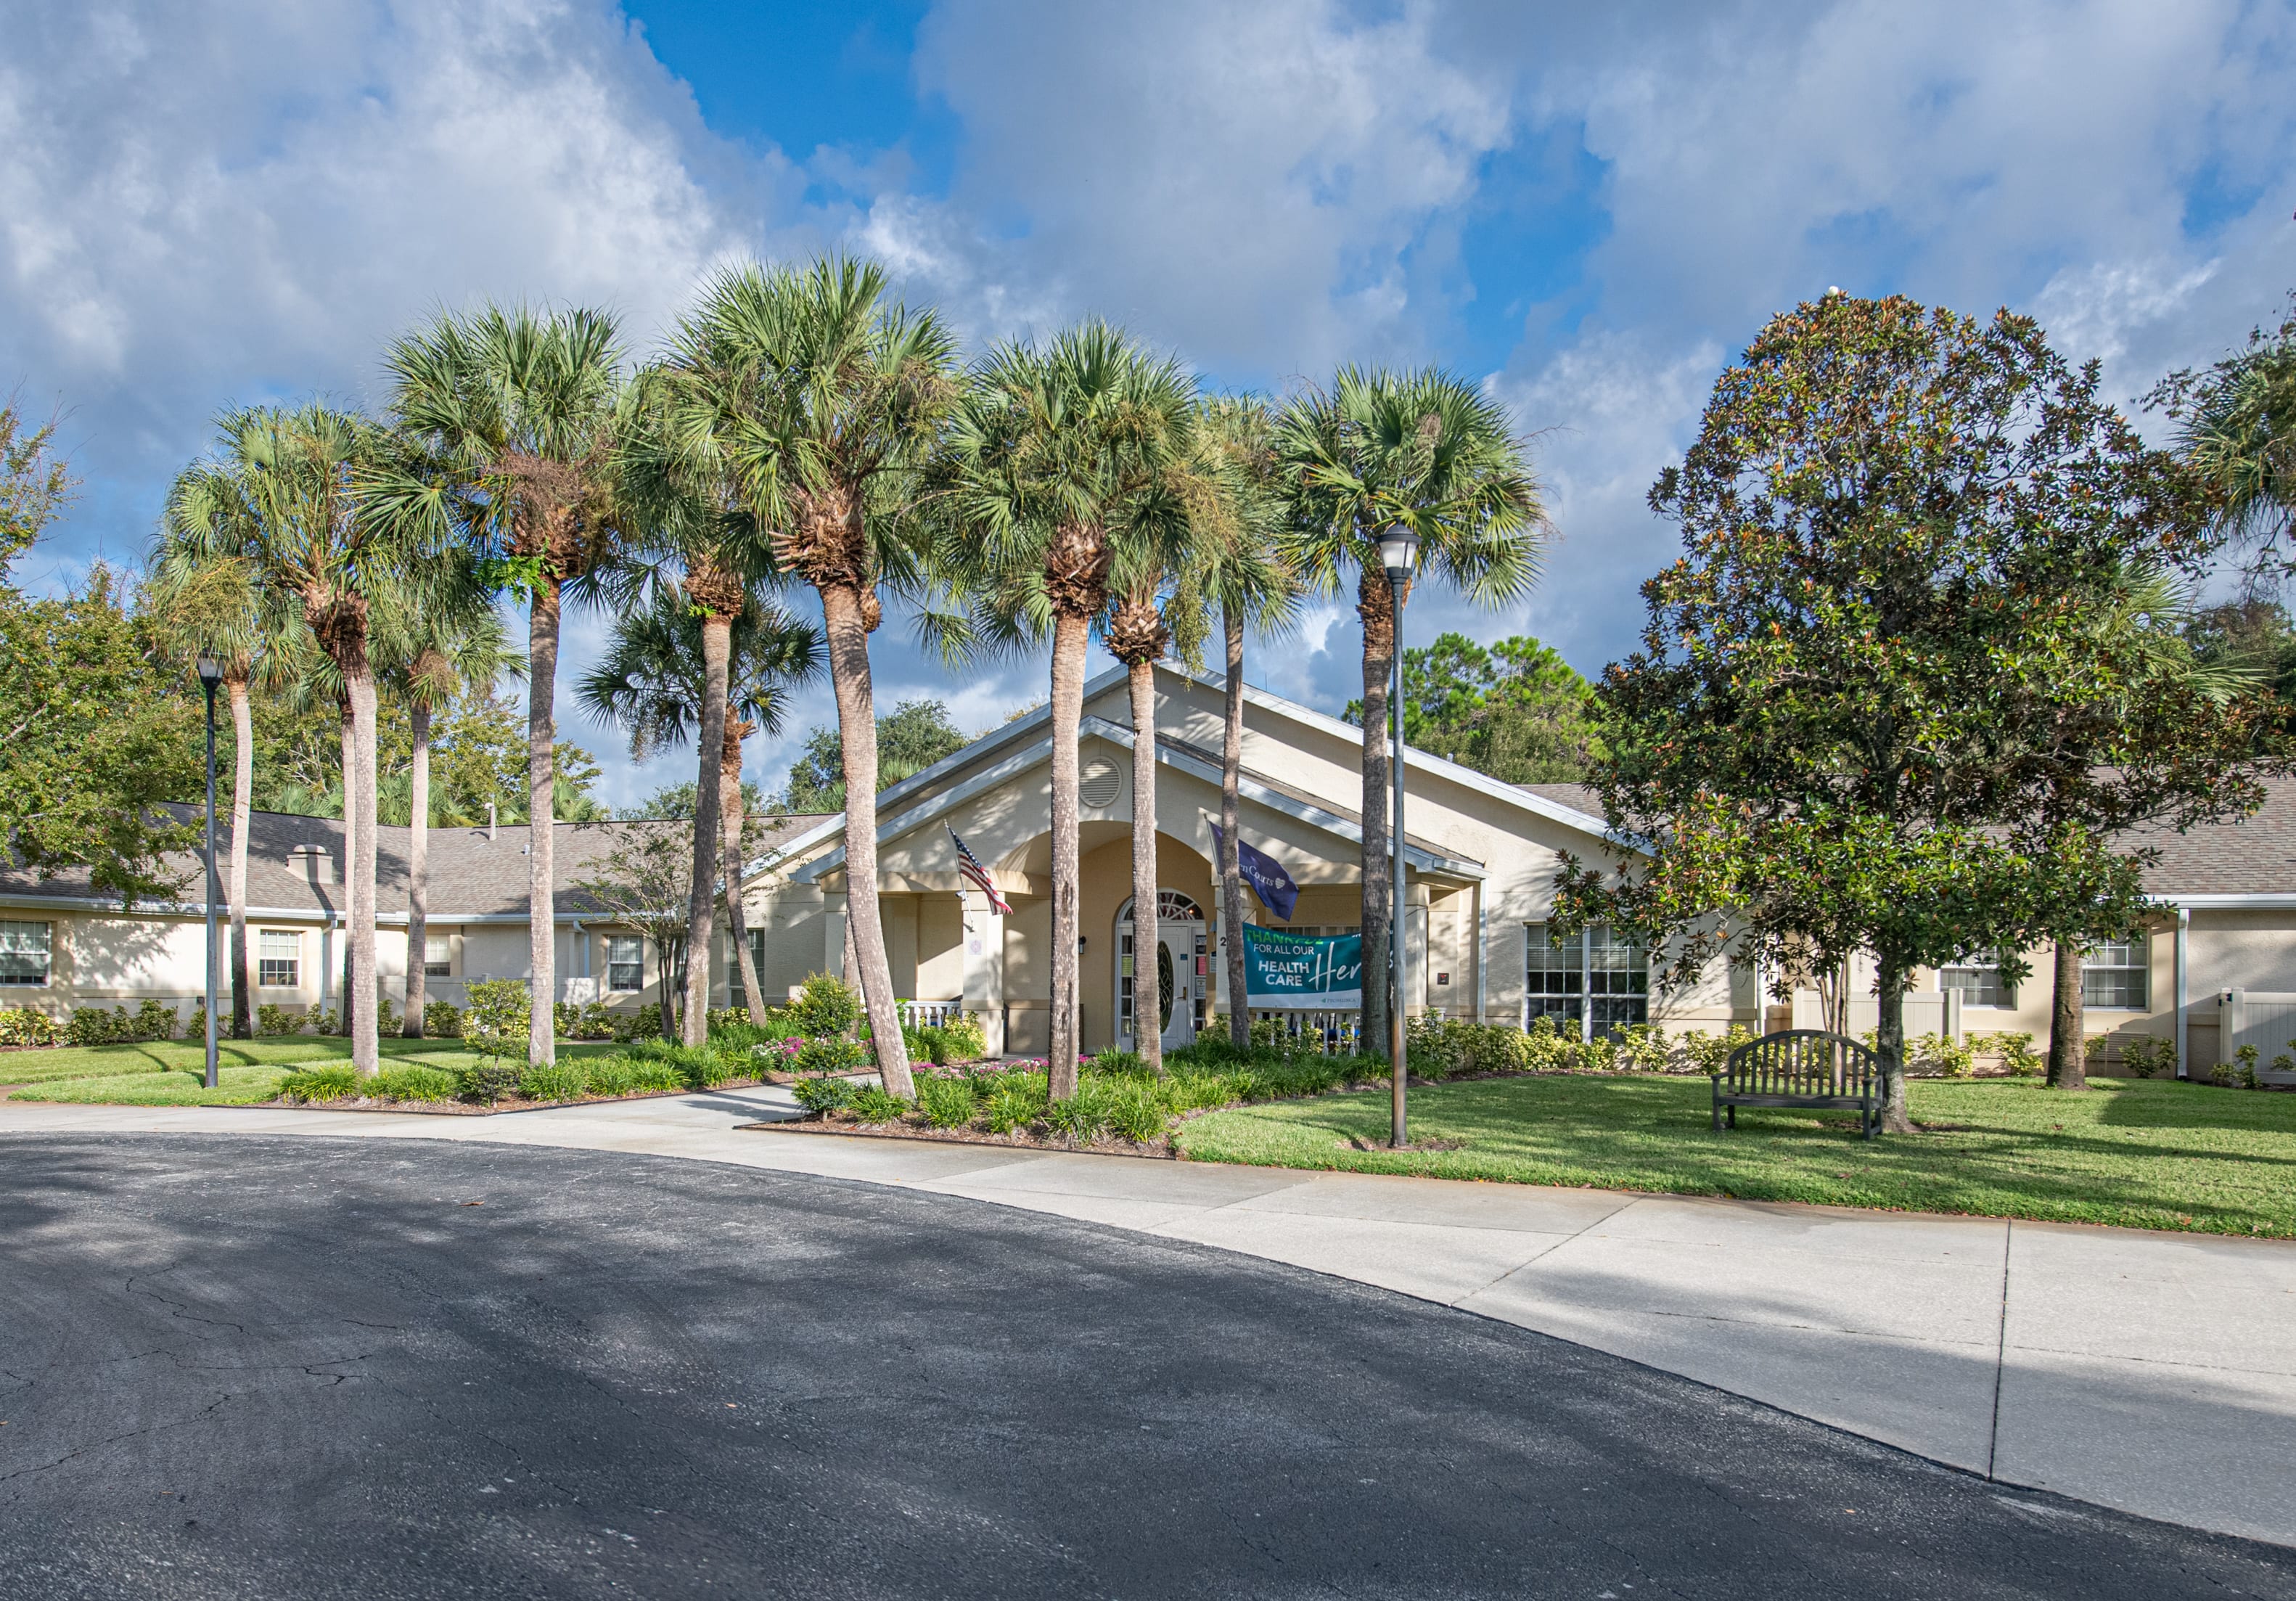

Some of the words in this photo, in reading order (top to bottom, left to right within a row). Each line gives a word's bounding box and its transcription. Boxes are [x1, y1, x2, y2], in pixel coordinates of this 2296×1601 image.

[1253, 943, 1272, 953] FOR
[1274, 945, 1291, 954] ALL
[1292, 946, 1315, 955] OUR
[1258, 960, 1309, 974] HEALTH
[1265, 975, 1303, 986] CARE
